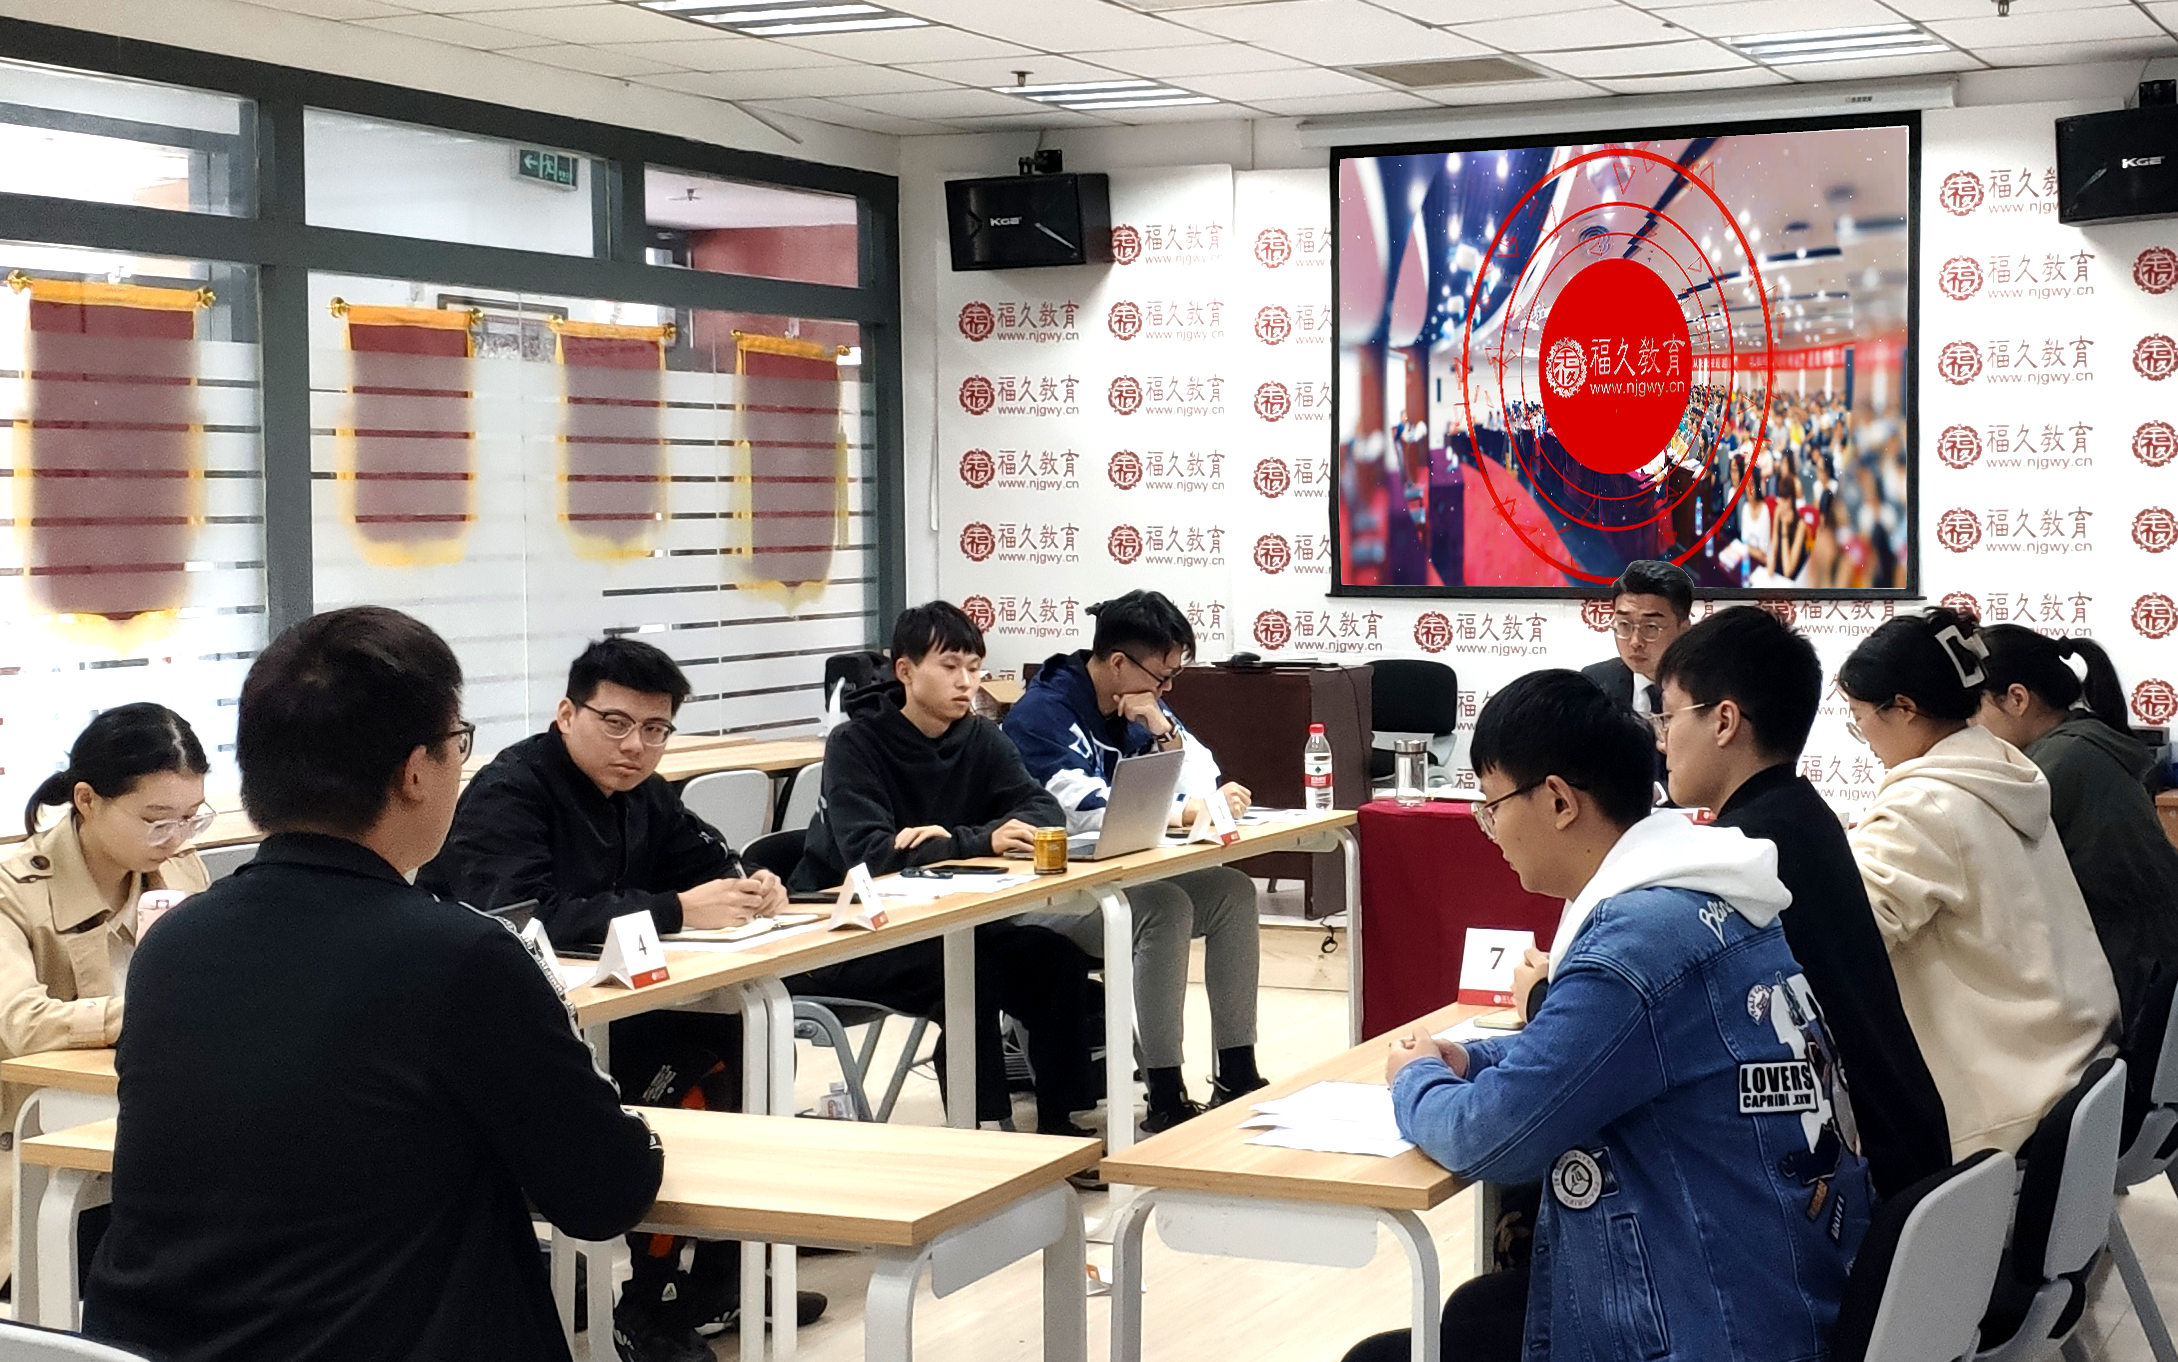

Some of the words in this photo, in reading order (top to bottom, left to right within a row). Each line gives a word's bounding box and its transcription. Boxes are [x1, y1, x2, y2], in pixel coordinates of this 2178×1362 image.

[1145, 222, 1223, 250] 福久教育
[1988, 250, 2095, 283] 福久教育
[1988, 287, 2094, 299] www.njgwy.cn
[997, 301, 1080, 329] 福久教育
[1146, 299, 1224, 326] 福久教育
[997, 331, 1080, 343] www.njgwy.cn
[1590, 333, 1686, 376] 福久教育
[1987, 335, 2094, 368] 福久教育
[998, 374, 1080, 402] 福久教育
[1146, 374, 1224, 402] 福久教育
[1590, 379, 1684, 397] www.njgwy.cn
[1987, 372, 2093, 385] www.njgwy.cn
[998, 405, 1080, 417] www.njgwy.cn
[1146, 407, 1224, 417] www.njgwy.cn
[1986, 421, 2093, 454] 福久教育
[997, 449, 1079, 477] 福久教育
[1146, 450, 1225, 478] 福久教育
[1986, 458, 2092, 470] www.njgwy.cn
[998, 478, 1079, 491] www.njgwy.cn
[1146, 480, 1224, 492] www.njgwy.cn
[1986, 506, 2093, 539] 福久教育
[998, 523, 1079, 551] 福久教育
[1146, 525, 1225, 554] 福久教育
[1986, 541, 2092, 554] www.njgwy.cn
[998, 552, 1079, 564] www.njgwy.cn
[1146, 556, 1224, 567] www.njgwy.cn
[998, 596, 1079, 625] 福久教育
[1986, 591, 2092, 624] 福久教育
[998, 626, 1079, 638] www.njgwy.cn
[1294, 609, 1383, 639] 福久教育
[1456, 612, 1547, 642] 福久教育
[1294, 640, 1382, 653] www.njgwy.cn
[1456, 643, 1546, 657] www.njgwy.cn
[638, 934, 647, 955] 4
[1490, 947, 1505, 969] 7
[1741, 1065, 1815, 1093] LOVERS
